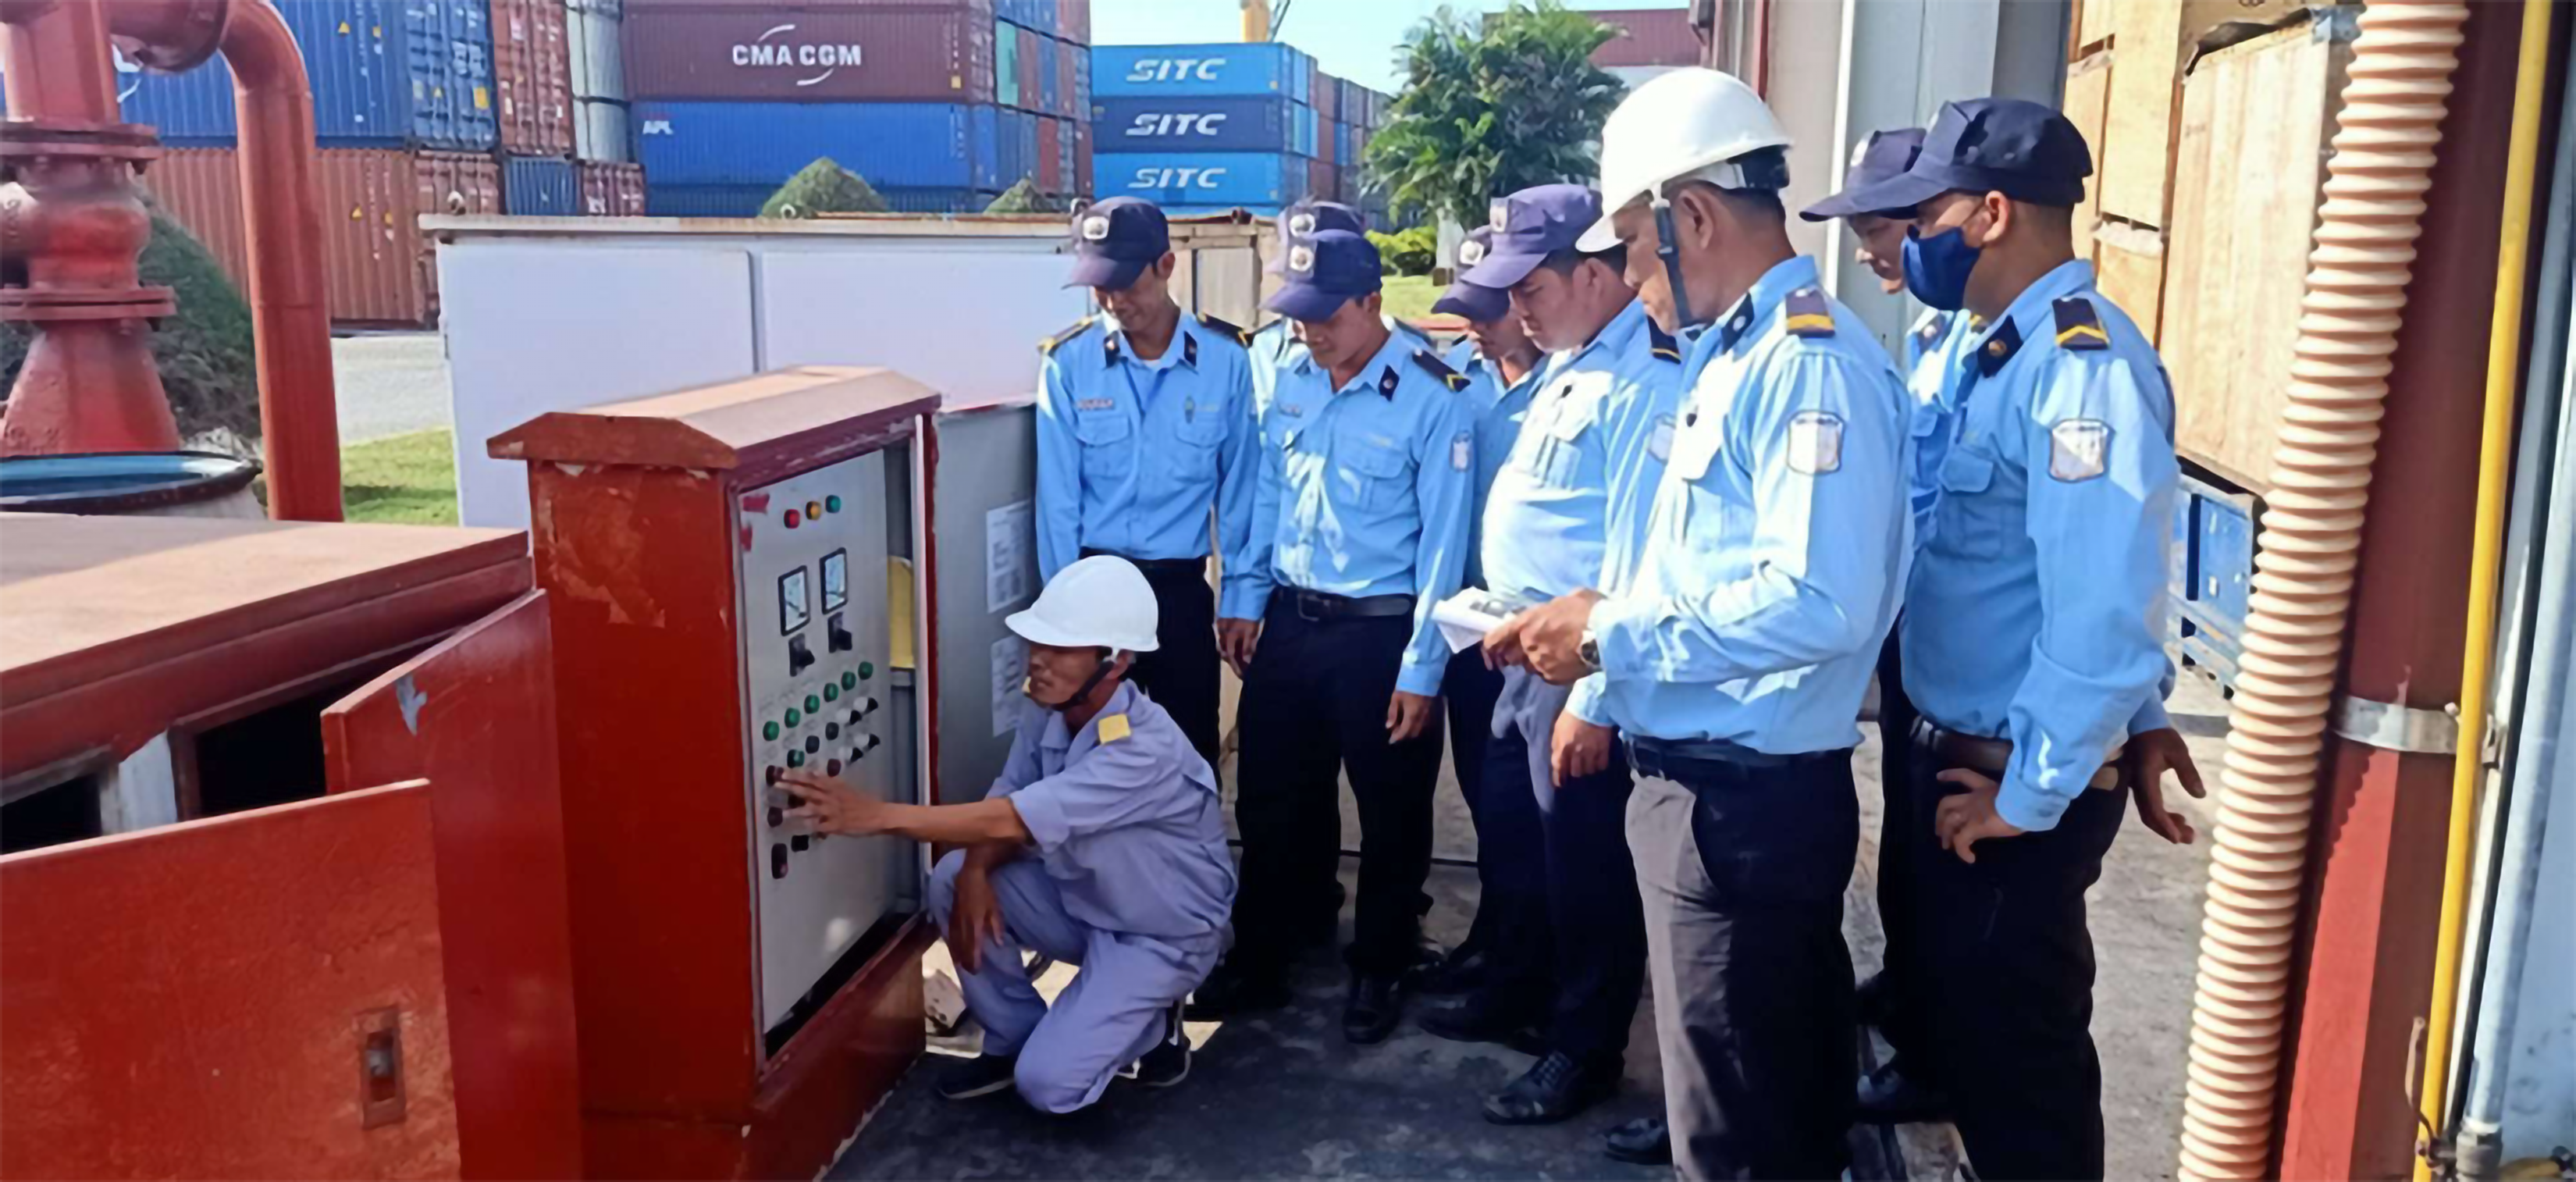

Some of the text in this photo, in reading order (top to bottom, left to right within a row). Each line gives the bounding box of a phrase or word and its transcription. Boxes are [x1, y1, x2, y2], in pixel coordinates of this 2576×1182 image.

[732, 44, 862, 66] CMA CGM
[1126, 58, 1226, 82] SITC
[1126, 113, 1227, 136] SITC
[1126, 167, 1227, 188] SITC
